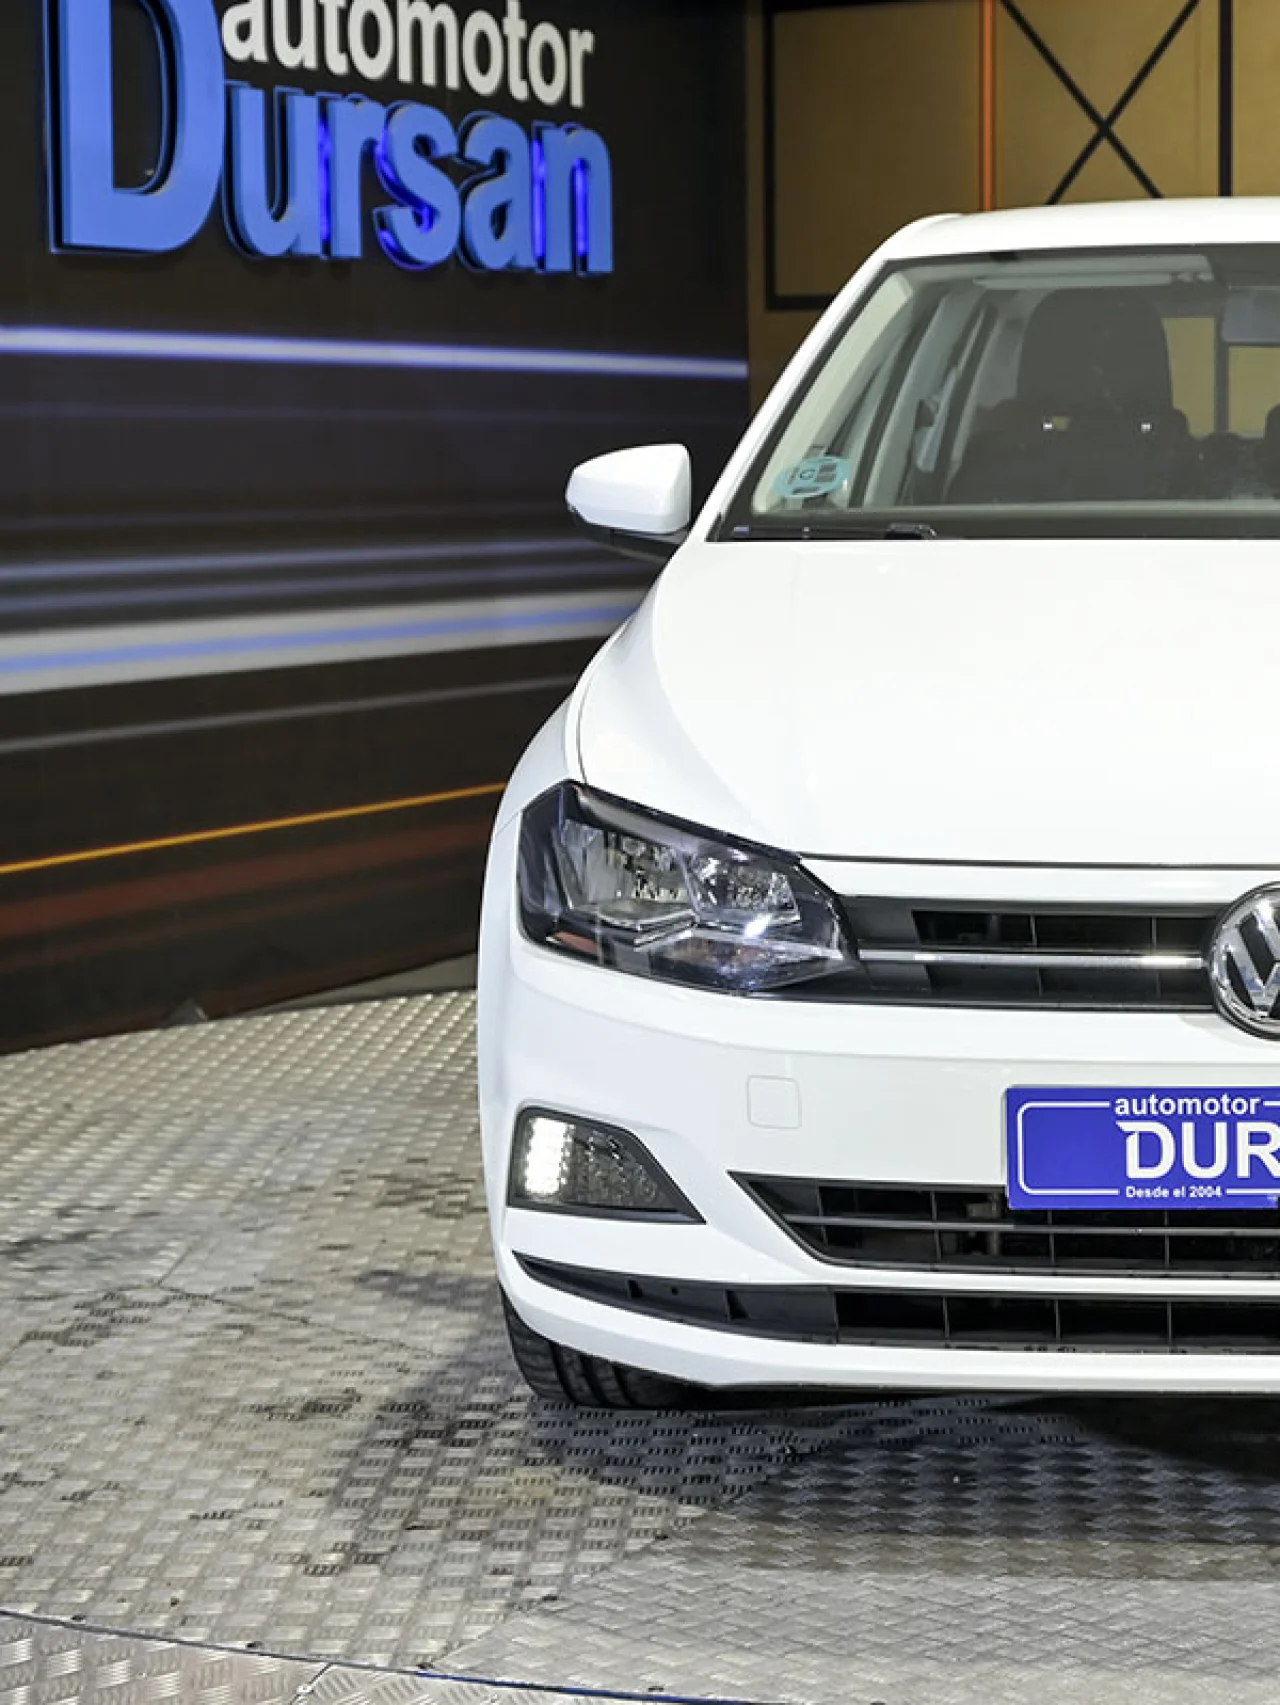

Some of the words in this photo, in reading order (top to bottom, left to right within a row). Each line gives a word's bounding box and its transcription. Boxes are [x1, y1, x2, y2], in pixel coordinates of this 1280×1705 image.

[221, 0, 596, 108] automotor
[46, 0, 614, 275] Dursan
[1115, 1093, 1262, 1116] automotor
[1125, 1185, 1170, 1198] Desde
[1172, 1185, 1186, 1198] el
[1188, 1185, 1223, 1198] 2004
